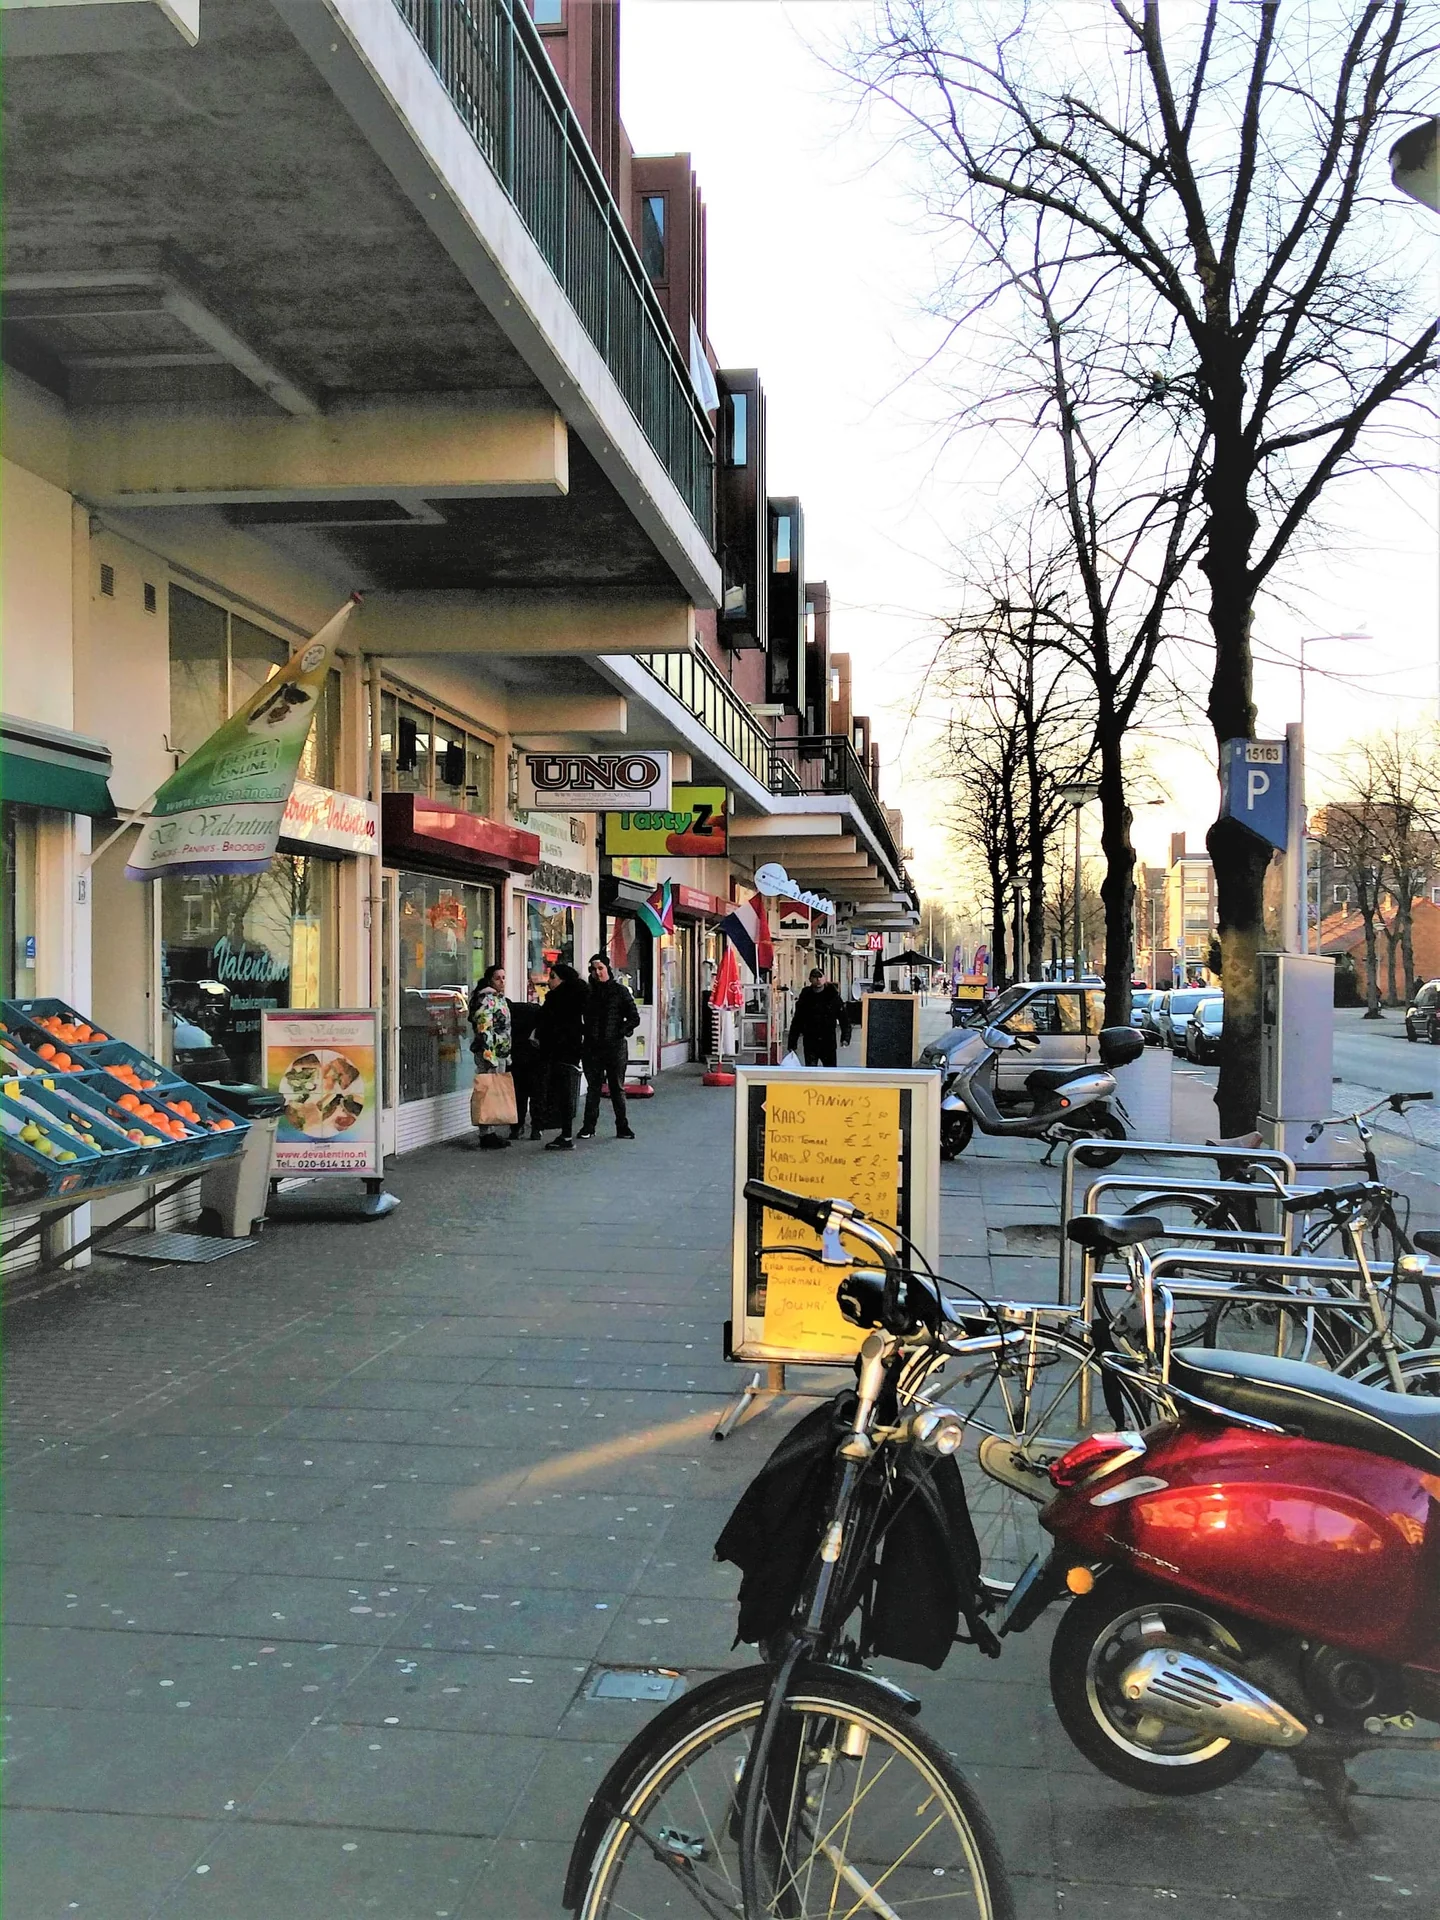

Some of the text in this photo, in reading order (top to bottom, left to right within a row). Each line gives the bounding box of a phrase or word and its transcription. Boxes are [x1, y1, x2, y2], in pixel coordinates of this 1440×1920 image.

[1246, 748, 1279, 760] 15163
[221, 760, 267, 779] ONLINE
[526, 755, 660, 789] UNO
[1247, 770, 1270, 810] P
[222, 841, 265, 852] BROODJES
[793, 892, 829, 912] SLEUTELS
[214, 936, 289, 981] Valentino
[772, 1105, 806, 1124] KAAS
[275, 1150, 367, 1159] www.devalentino.nl
[298, 1160, 337, 1168] 020-614
[354, 1160, 366, 1168] 20
[770, 1148, 796, 1163] KAAS
